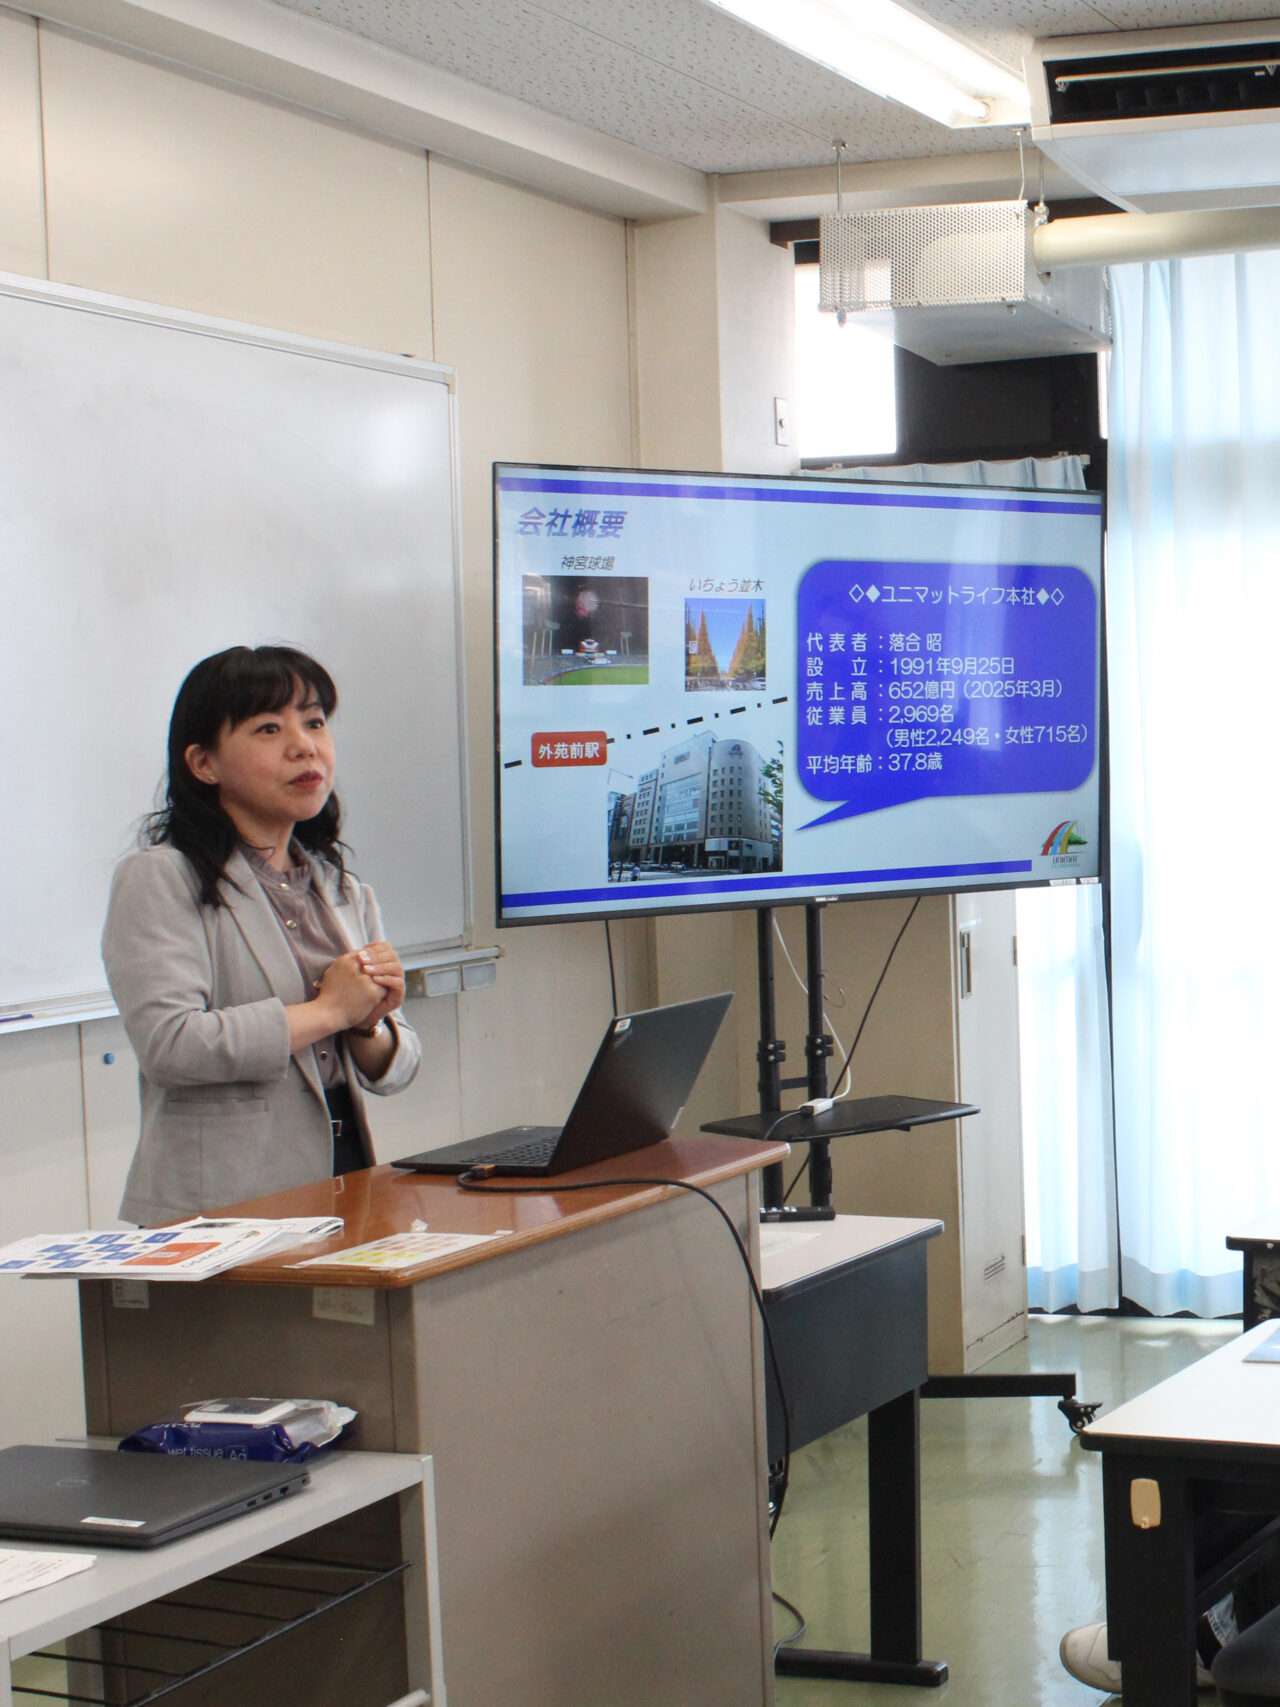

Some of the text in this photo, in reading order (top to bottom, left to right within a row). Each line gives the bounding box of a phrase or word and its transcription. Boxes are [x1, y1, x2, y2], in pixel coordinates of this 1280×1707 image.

[516, 507, 628, 539] 会社概要
[560, 555, 616, 571] 神宮球場
[689, 578, 766, 593] いちょう並木
[538, 741, 600, 760] 外苑前駅
